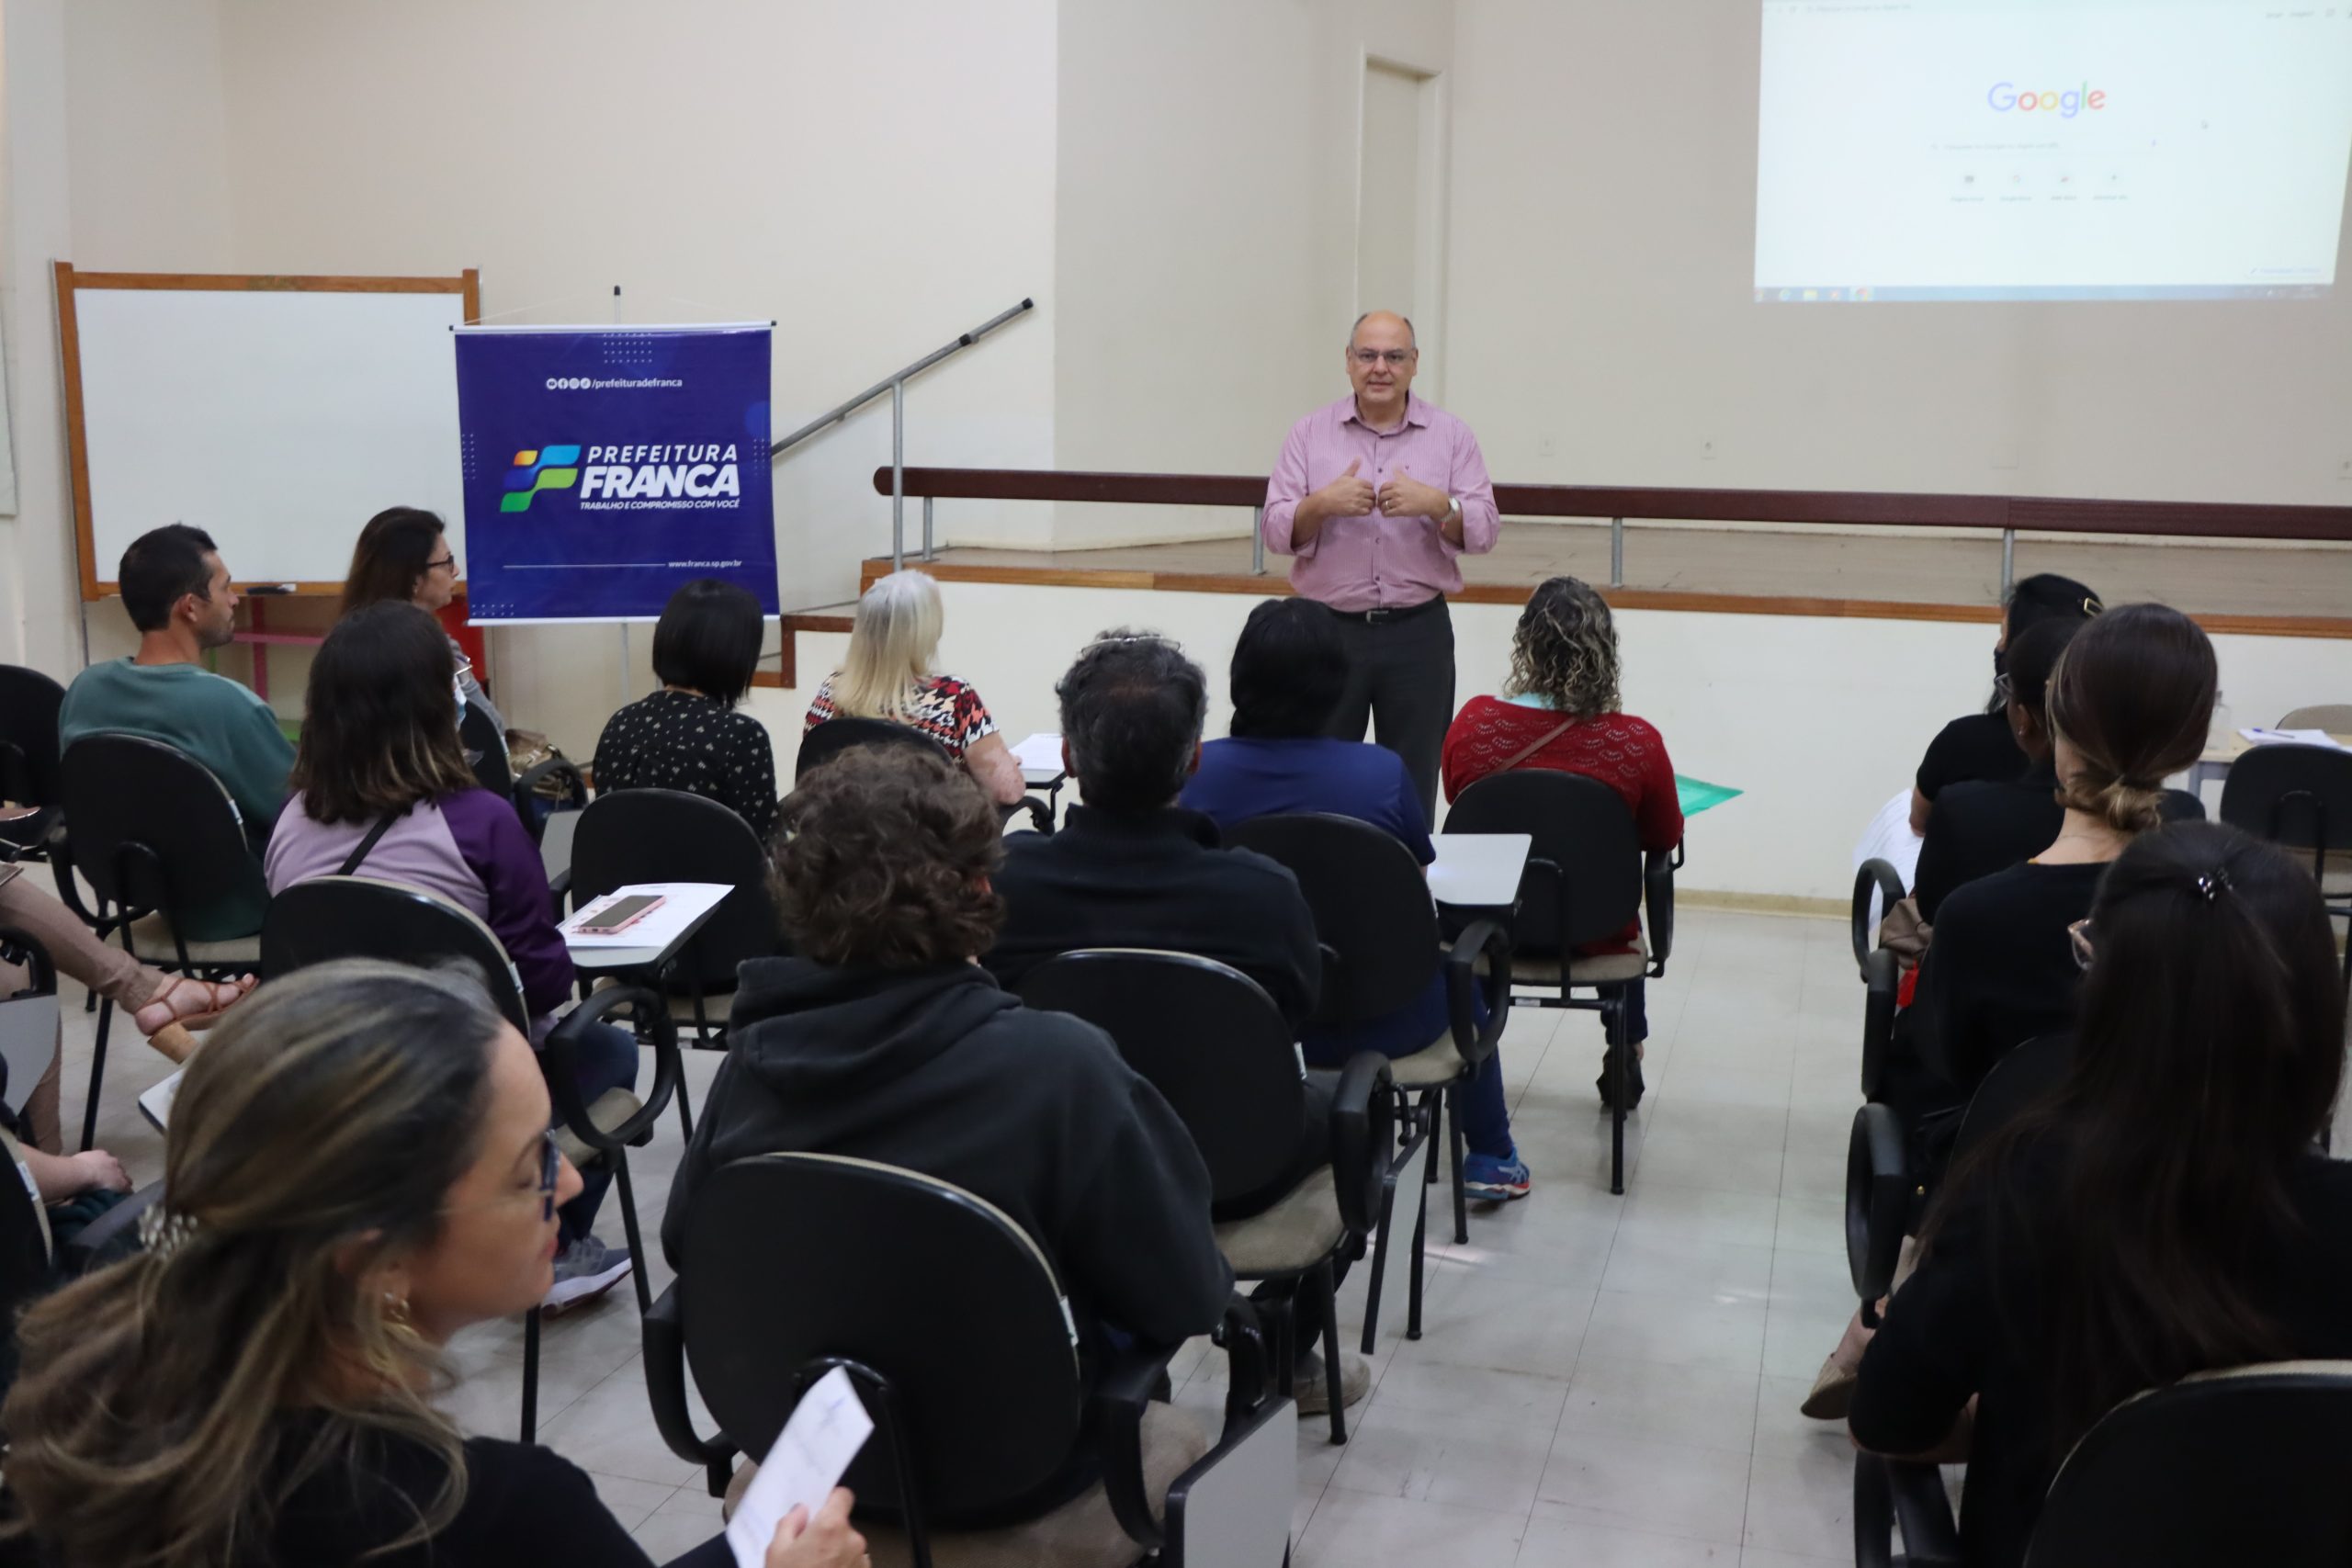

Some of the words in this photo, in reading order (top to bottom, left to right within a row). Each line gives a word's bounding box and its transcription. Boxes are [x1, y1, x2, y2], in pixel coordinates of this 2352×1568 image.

[1987, 80, 2107, 118] Google
[591, 378, 683, 389] /prefeituradefranca
[587, 444, 738, 464] PREFEITURA
[580, 464, 741, 499] FRANCA
[581, 501, 624, 510] TRABALHO
[625, 501, 630, 510] E
[631, 500, 694, 509] COMPROMISSO
[695, 500, 716, 509] COM
[668, 559, 742, 569] www.franca.sp.gov.br
